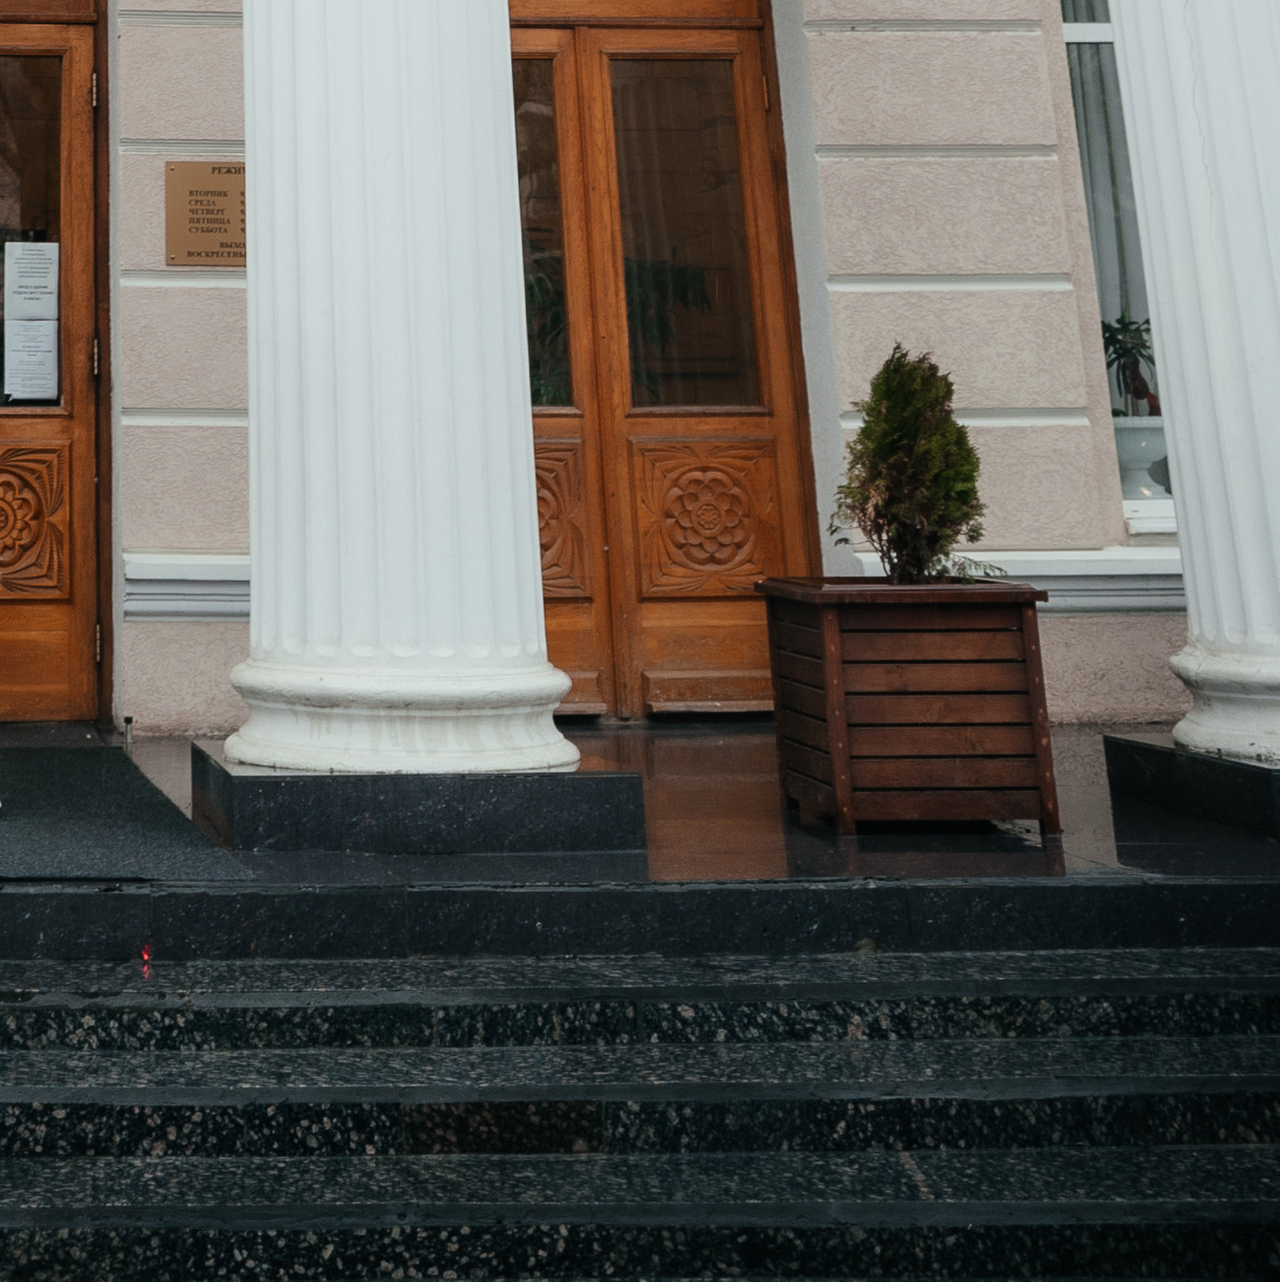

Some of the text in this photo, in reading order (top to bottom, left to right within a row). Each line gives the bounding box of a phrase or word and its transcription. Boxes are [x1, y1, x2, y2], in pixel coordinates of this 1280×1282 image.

[211, 166, 245, 175] РЕЖИ
[188, 217, 231, 225] ПЯТНИЦА
[188, 226, 228, 234] СУББОТА
